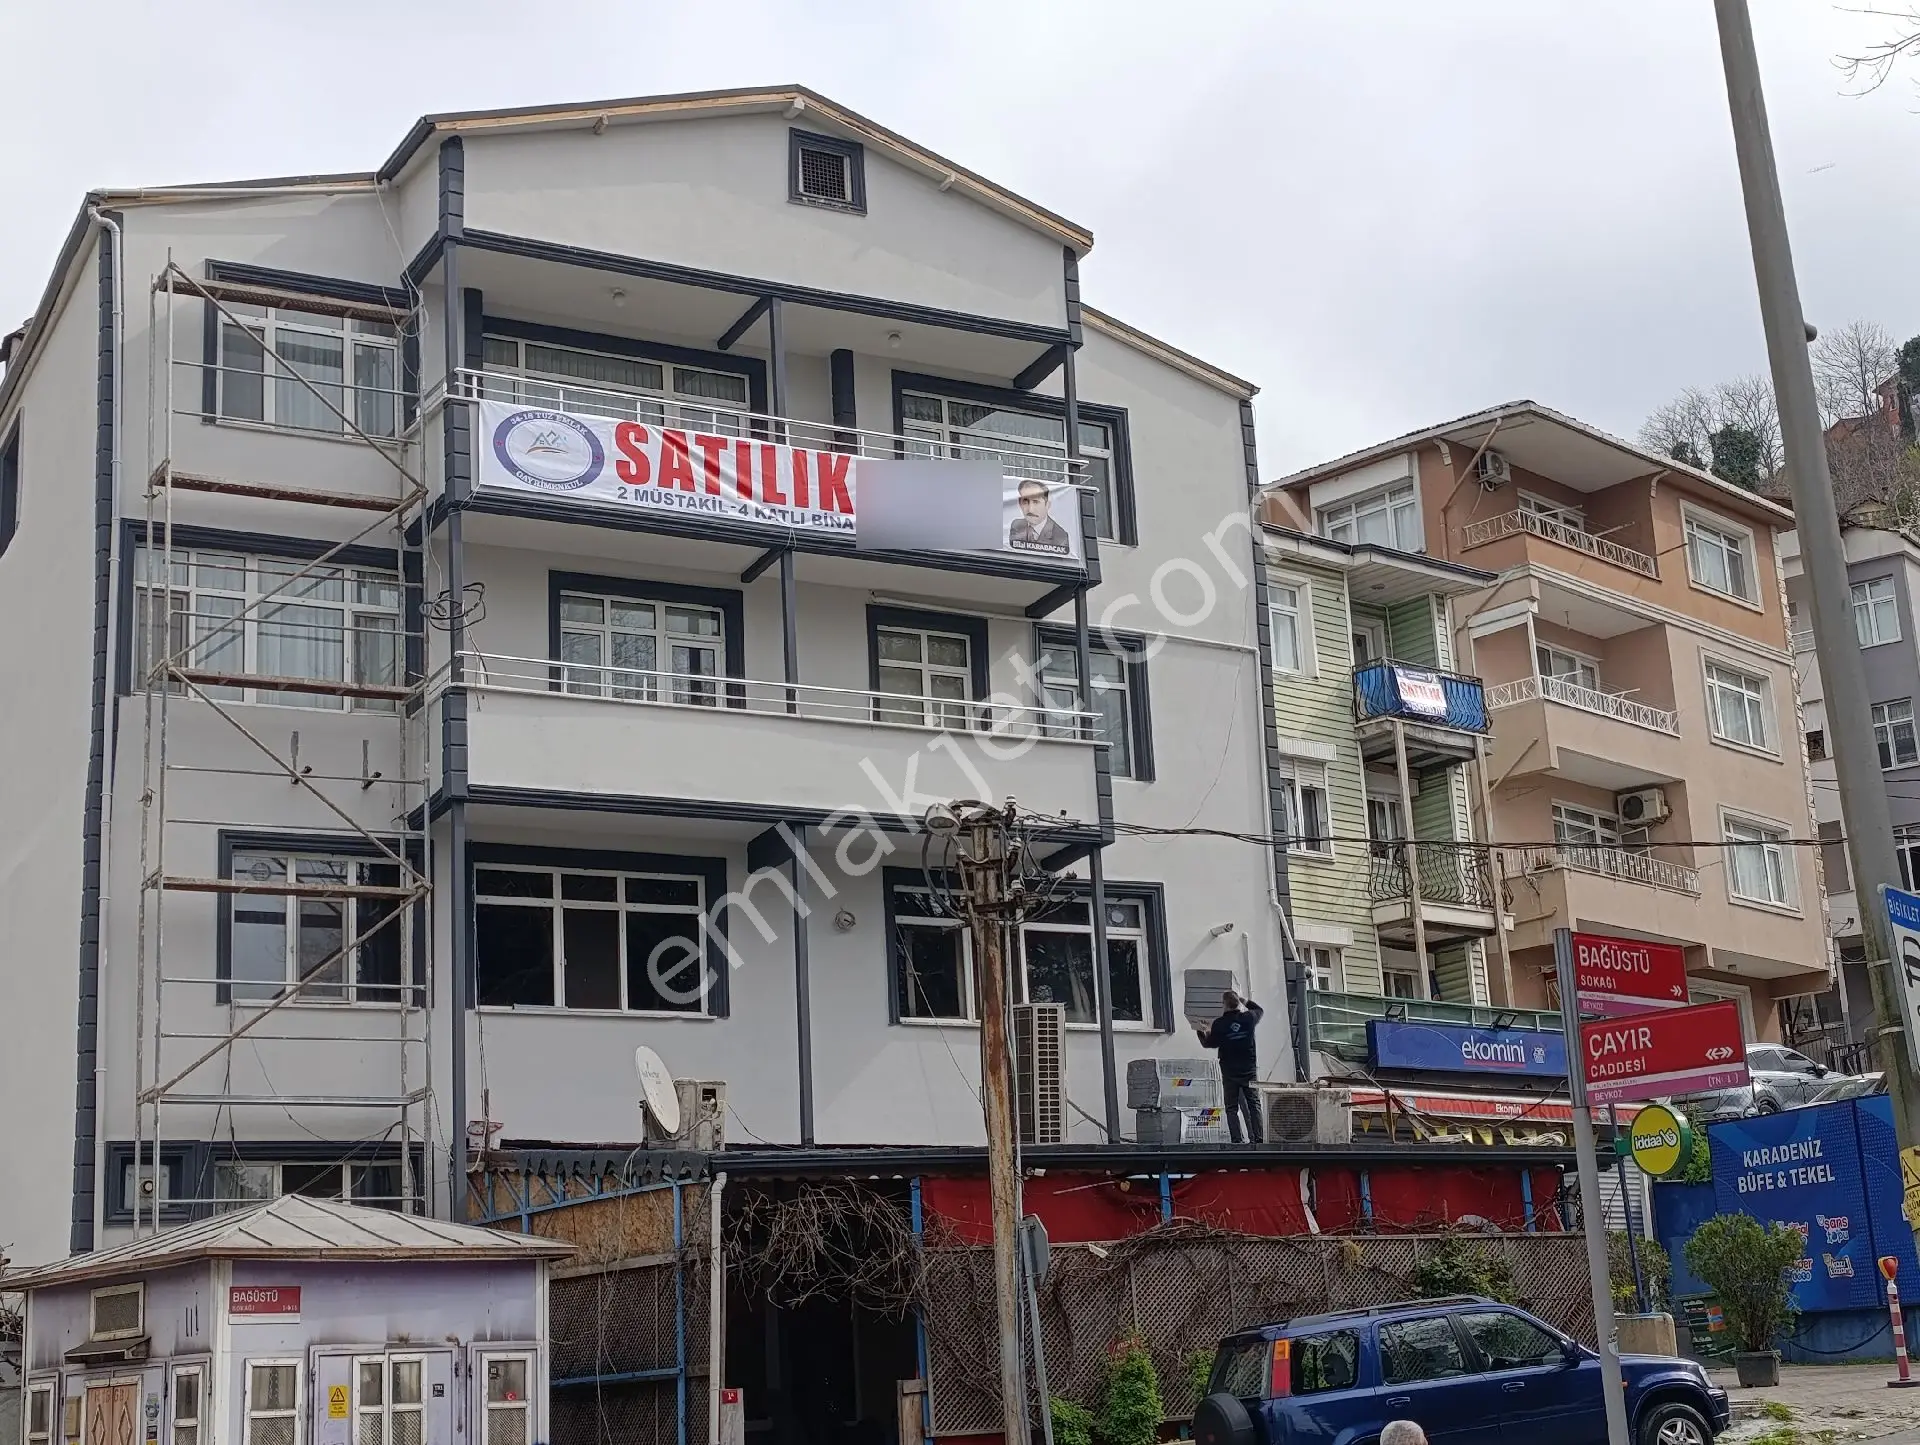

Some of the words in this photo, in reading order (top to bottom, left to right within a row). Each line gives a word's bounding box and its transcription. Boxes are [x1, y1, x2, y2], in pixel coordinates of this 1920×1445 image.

[556, 415, 588, 435] EMLAK
[614, 420, 854, 515] SATILIK
[617, 486, 628, 500] 2
[755, 507, 806, 525] KATLI
[812, 513, 854, 531] BİNA
[1026, 542, 1067, 554] KARABACAK
[1578, 944, 1650, 975] BAĞÜSTÜ
[1580, 973, 1617, 990] SOKAĞI
[1582, 1001, 1605, 1011] BEYKOZ
[1462, 1035, 1525, 1063] ekomini
[1588, 1027, 1653, 1061] ÇAYIR
[1590, 1055, 1646, 1078] CADDESİ
[1594, 1089, 1623, 1102] BEYKOZ
[1495, 1103, 1523, 1114] Ekomini
[1634, 1133, 1663, 1150] iddaa
[1743, 1137, 1823, 1167] KARADENİZ
[1737, 1171, 1774, 1193] BÜFE
[1777, 1173, 1787, 1188] &
[1789, 1164, 1836, 1185] TEKEL
[233, 1289, 279, 1303] BAĞÜSTÜ
